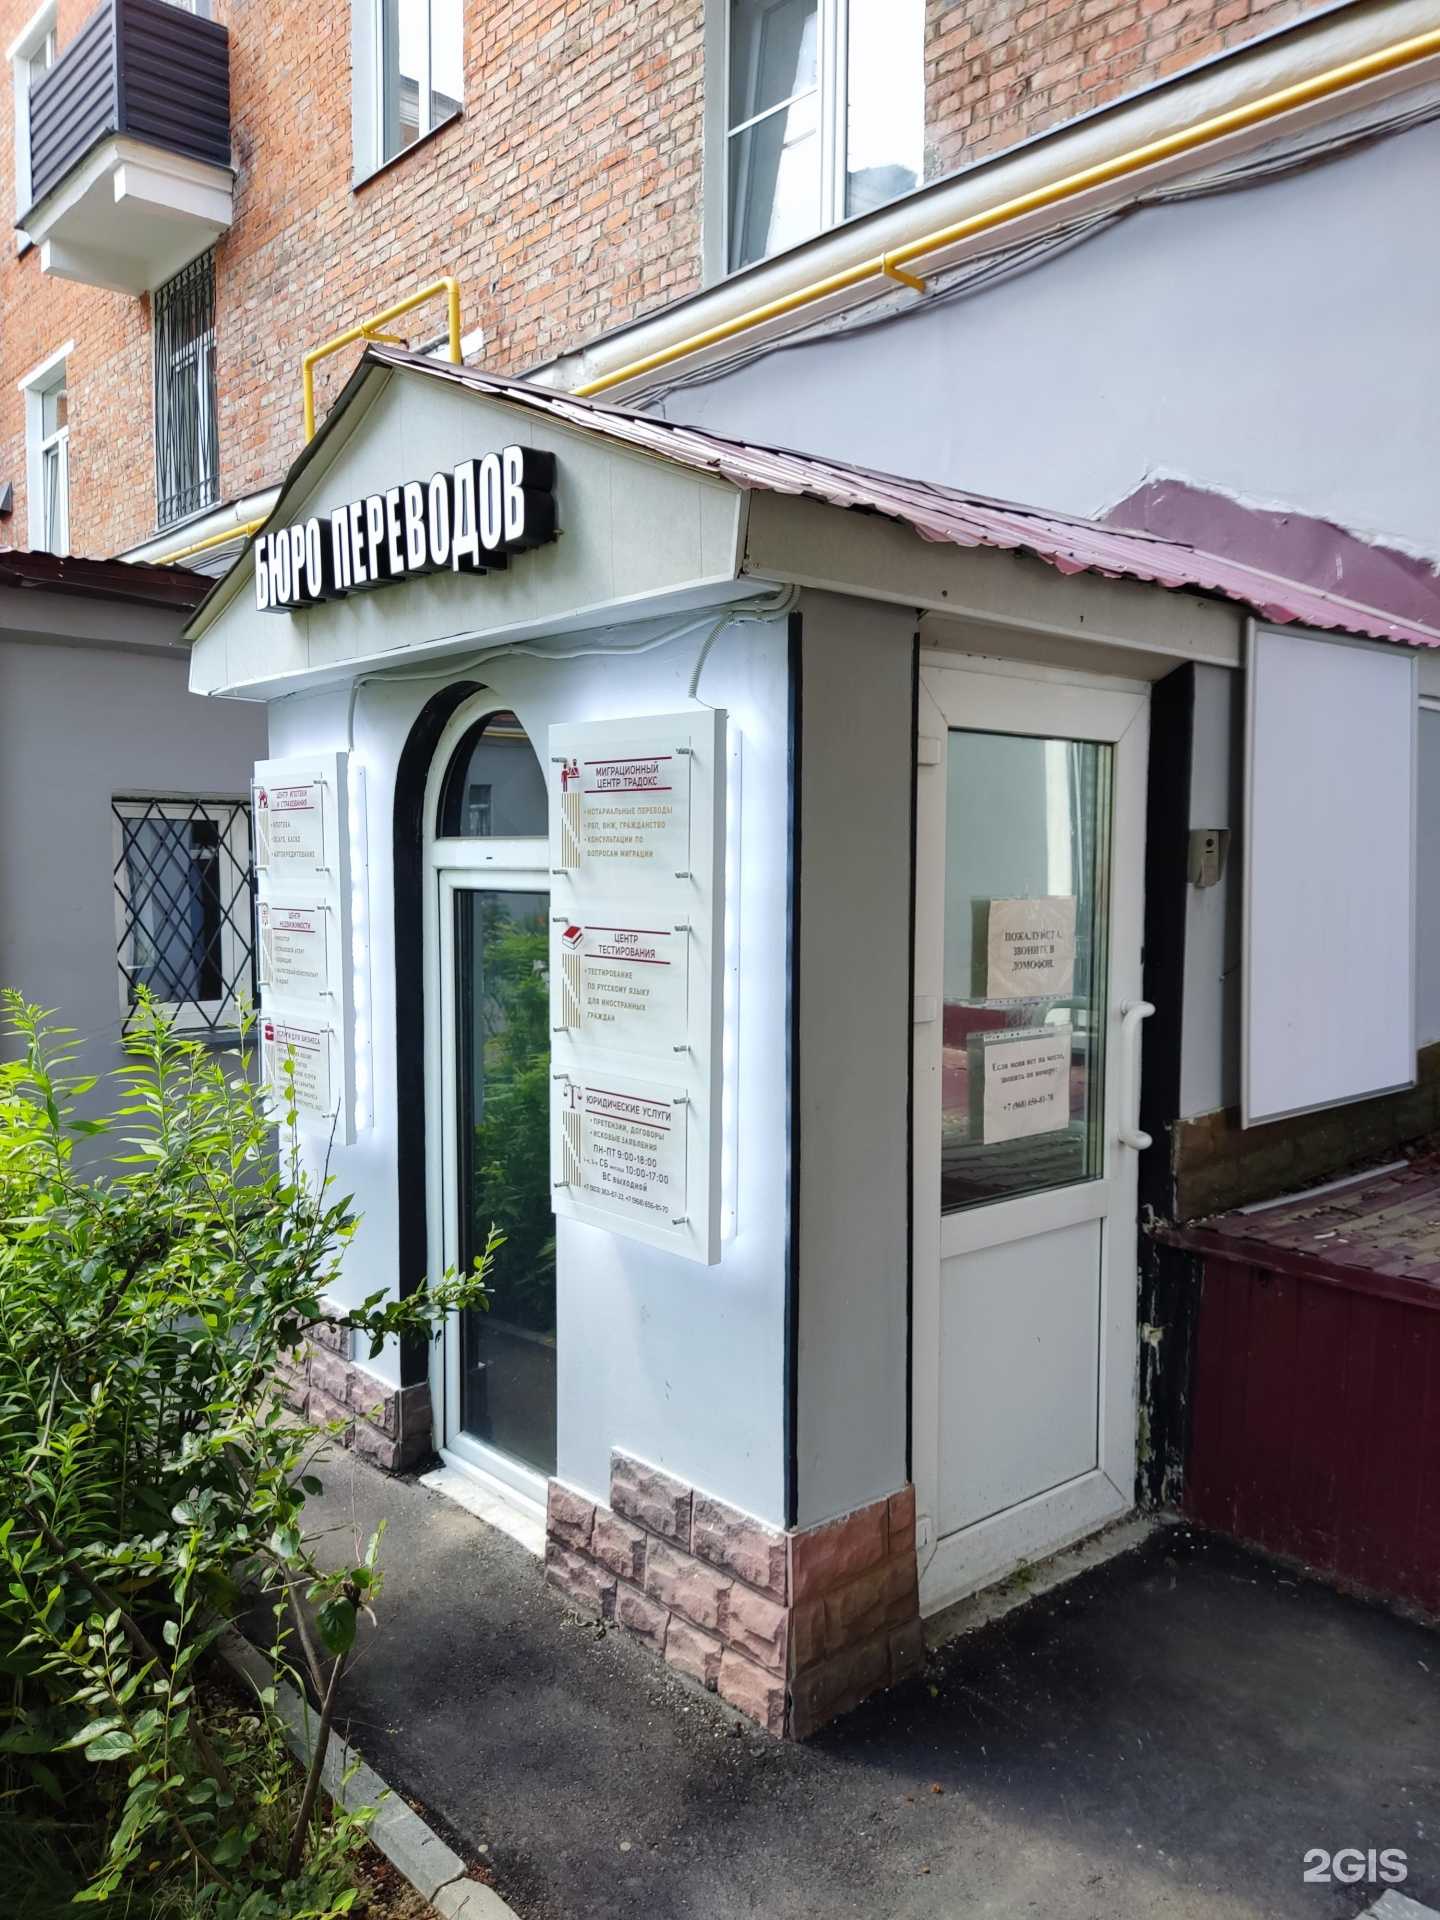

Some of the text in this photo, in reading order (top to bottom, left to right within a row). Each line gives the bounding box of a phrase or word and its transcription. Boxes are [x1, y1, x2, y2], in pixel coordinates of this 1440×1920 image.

[255, 445, 526, 612] БЮРО ПЕРЕВОДОВ
[595, 761, 659, 777] МИГРАЦИОННЫЙ
[597, 776, 658, 789] ЦЕНТР ТРАДОКС
[587, 805, 673, 817] НОТАРИАЛЬНЫЕ ПЕРЕВОДЫ
[620, 820, 666, 830] ГРАЖДАНСТВО
[587, 835, 633, 844] КОНСУЛЬТАЦИИ
[587, 849, 654, 858] ВОПРОСАМ МИГРАЦИИ
[614, 933, 639, 944] ЦЕНТР
[598, 944, 656, 959] ТЕСТИРОВАНИЯ
[587, 967, 633, 980] ТЕСТИРОВАНИЕ
[587, 982, 650, 996] ПО РУССКОМУ ЯЗЫКУ
[587, 997, 646, 1011] ДЛЯ ИНОСТРАННЫХ
[587, 1011, 615, 1021] ГРАЖДАН
[586, 1095, 672, 1122] ЮРИДИЧЕСКИЕ УСЛУГИ
[630, 1126, 665, 1140] ДОГОВОРЫ
[593, 1130, 657, 1151] ИСКОВЫЕ ЗАЯВЛЕНИЯ
[593, 1143, 616, 1158] ПН-ПТ
[617, 1149, 657, 1168] 9:00-18:00
[599, 1158, 609, 1168] СБ
[625, 1165, 669, 1185] 10:00-17:00
[602, 1171, 611, 1182] ВС
